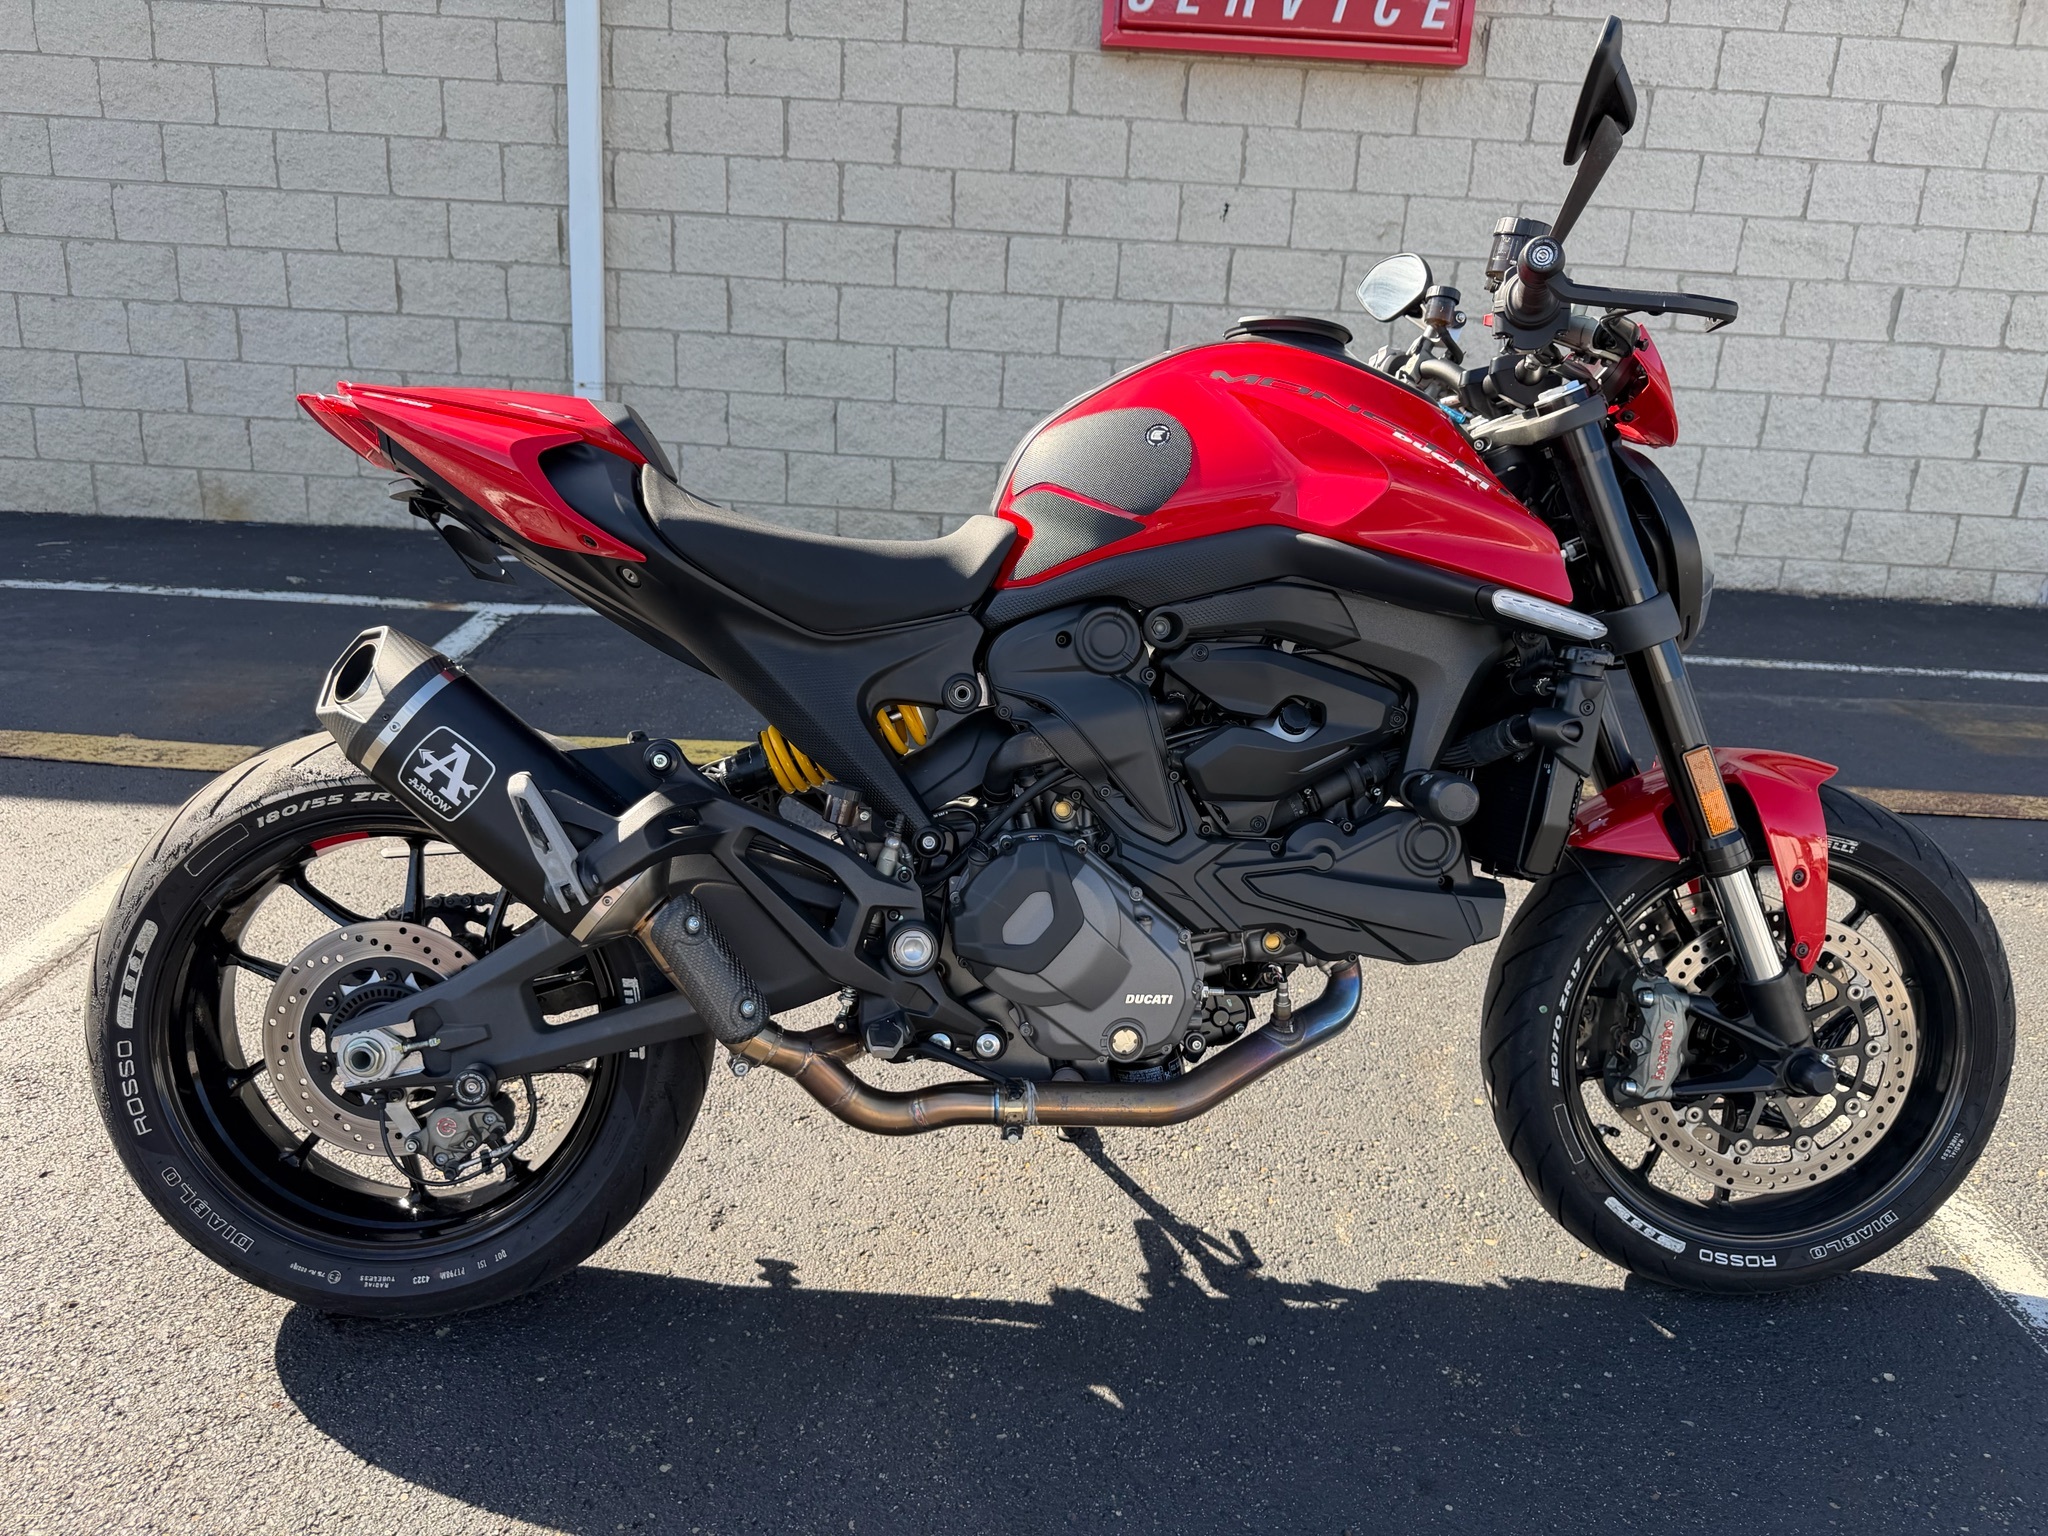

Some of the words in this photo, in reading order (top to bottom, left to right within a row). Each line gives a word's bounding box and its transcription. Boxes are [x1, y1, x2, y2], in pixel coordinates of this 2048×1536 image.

[1392, 430, 1489, 490] DUCATI
[257, 793, 344, 829] 180/55
[350, 791, 400, 804] ZR
[408, 778, 452, 812] ARROW
[1125, 994, 1173, 1005] DUCATI
[1550, 1015, 1563, 1088] 120/70
[1557, 957, 1582, 1012] ZR17
[1651, 1019, 1675, 1080] brembo
[117, 1040, 152, 1136] ROSSO
[1940, 1132, 1961, 1160] TUBELESS
[1949, 1137, 1965, 1158] RADIAL
[161, 1166, 254, 1252] DIABLO
[1809, 1209, 1899, 1260] DIABLO
[1699, 1248, 1777, 1268] ROSSO
[412, 1275, 430, 1285] 4323
